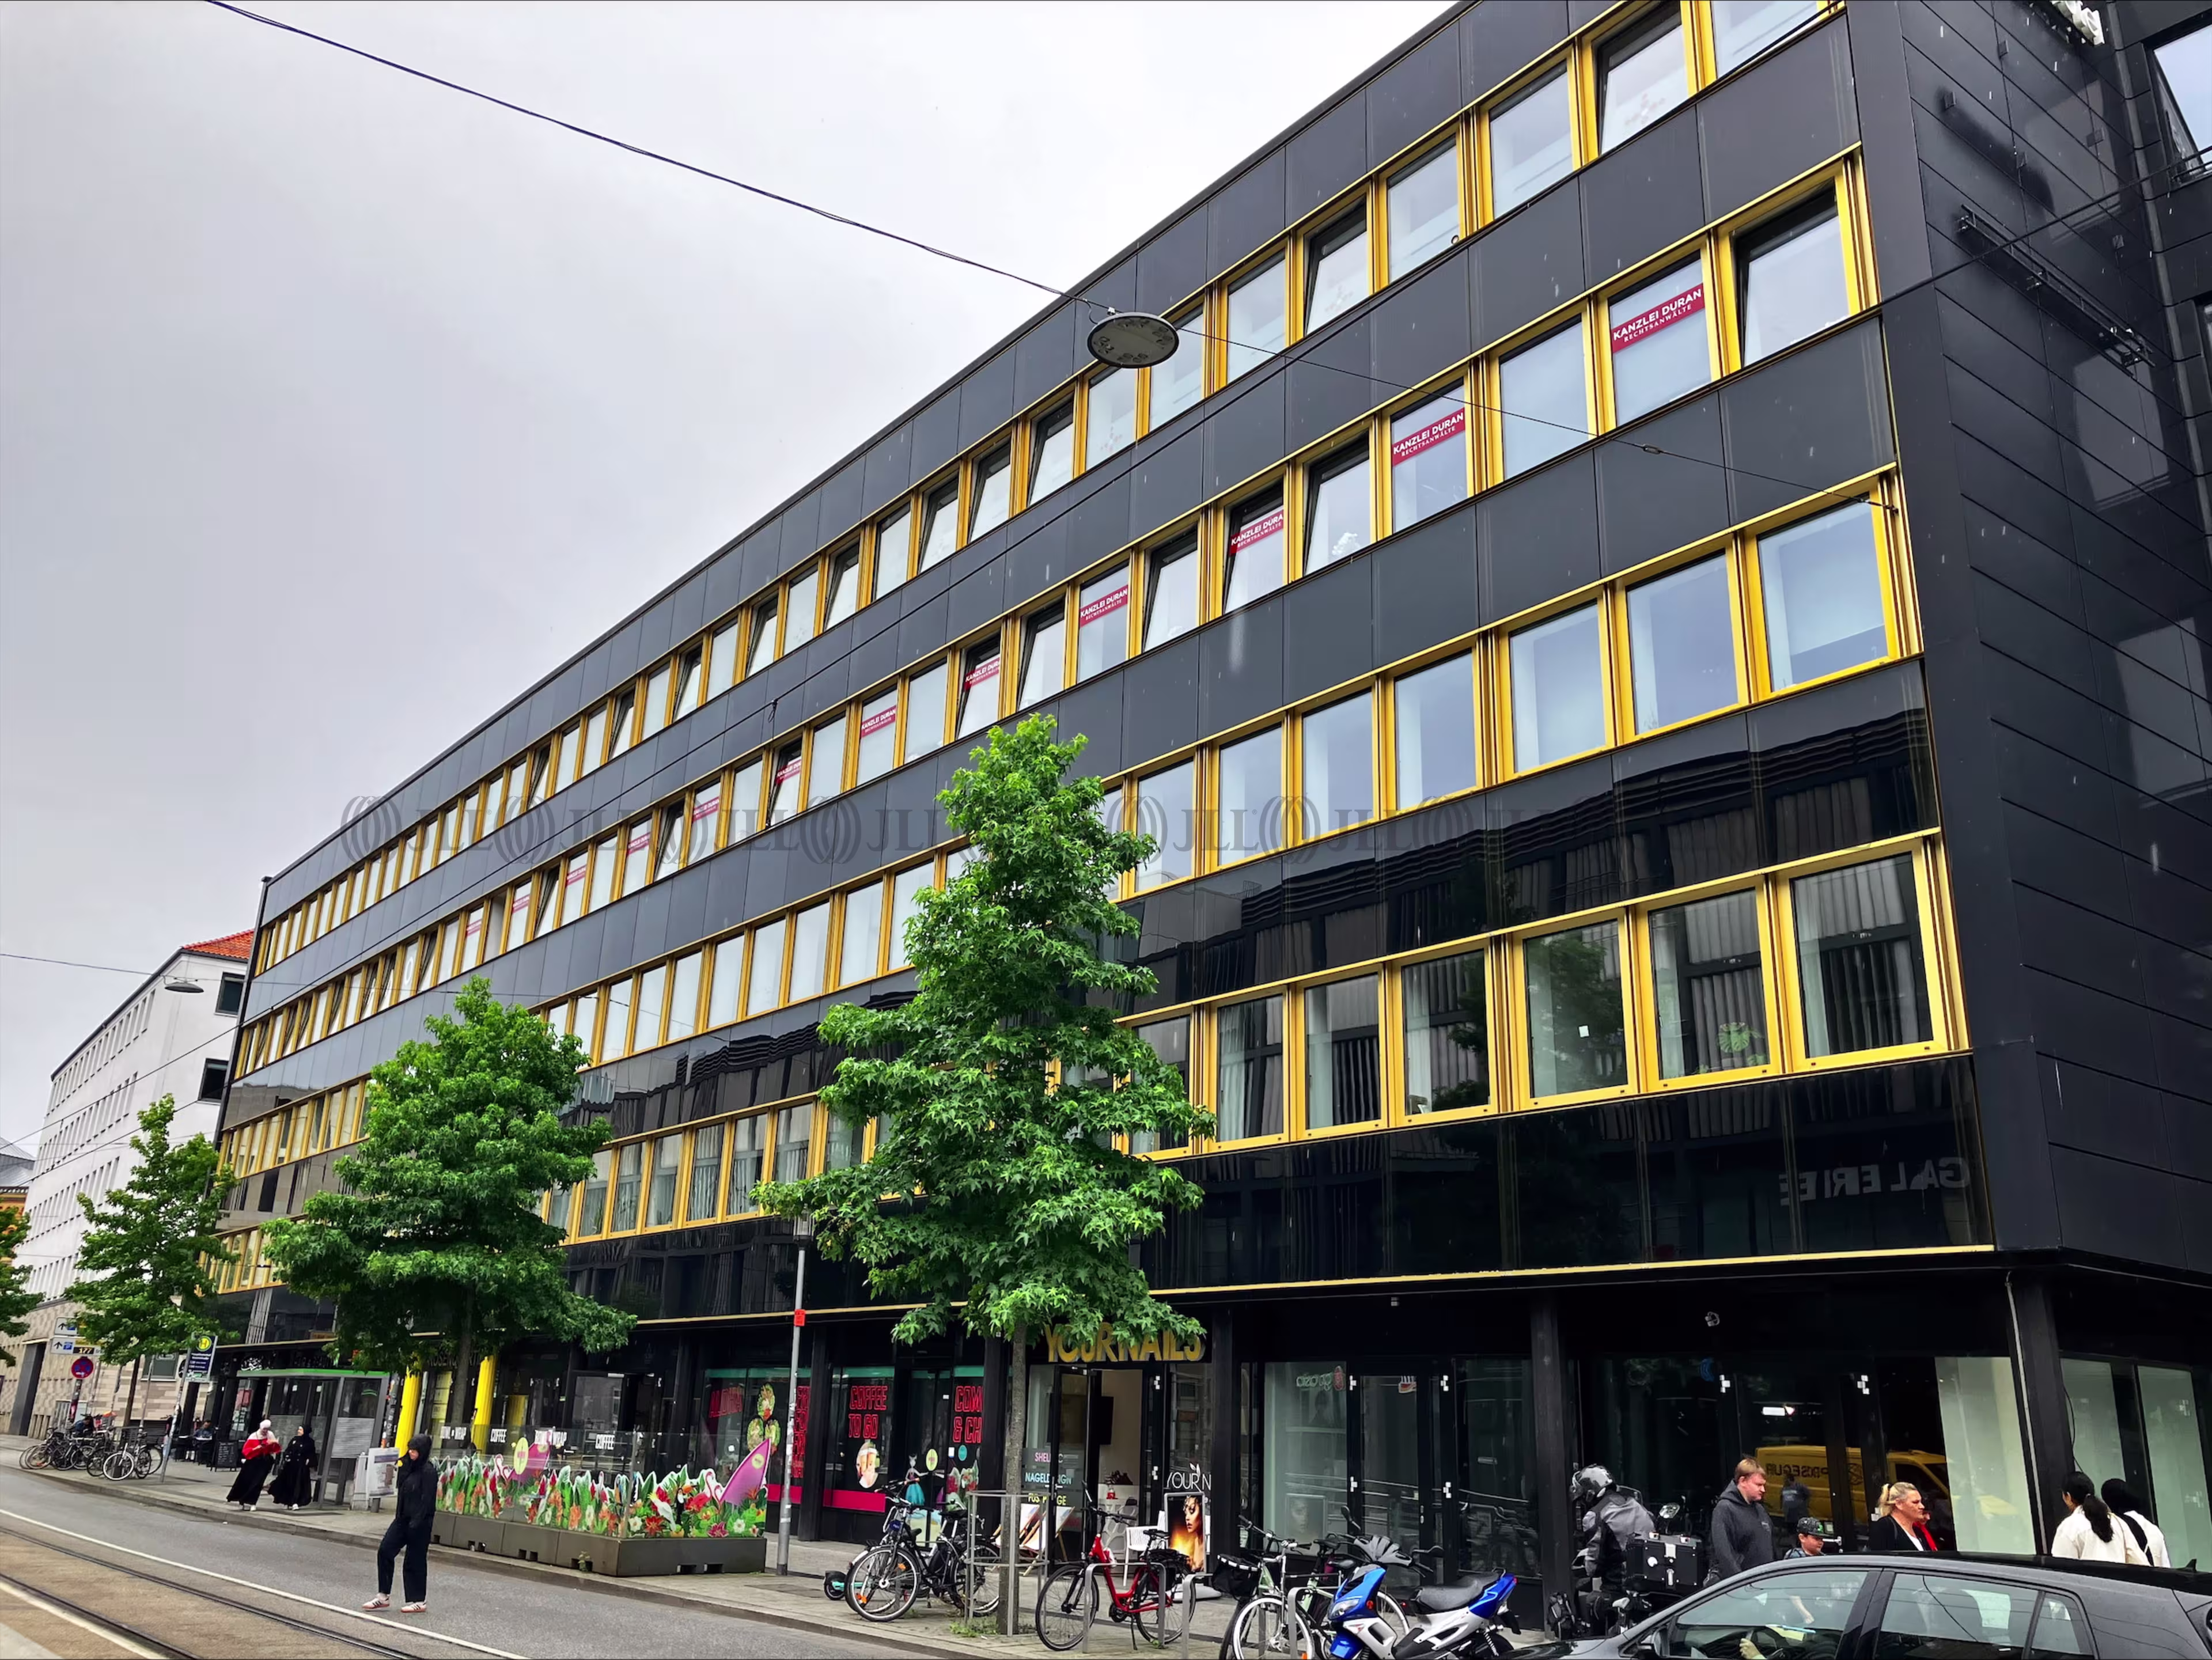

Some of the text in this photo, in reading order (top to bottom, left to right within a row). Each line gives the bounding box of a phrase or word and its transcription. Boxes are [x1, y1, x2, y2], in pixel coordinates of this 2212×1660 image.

[1613, 289, 1702, 340] KANZLEI DURAN
[1624, 305, 1692, 342] RECHTSANWÄLTE
[1393, 412, 1464, 454] KANZLEI DURAN
[1401, 426, 1456, 457] RECHTSANWÄLTE
[1231, 525, 1262, 545] KANZLEI
[1080, 589, 1128, 618] KANZLEI DURAN
[849, 1385, 888, 1411] COFFEE
[490, 1428, 507, 1443] COFFEE
[848, 1413, 879, 1439] TO GO
[952, 1416, 964, 1443] &
[595, 1434, 615, 1450] COFFEE
